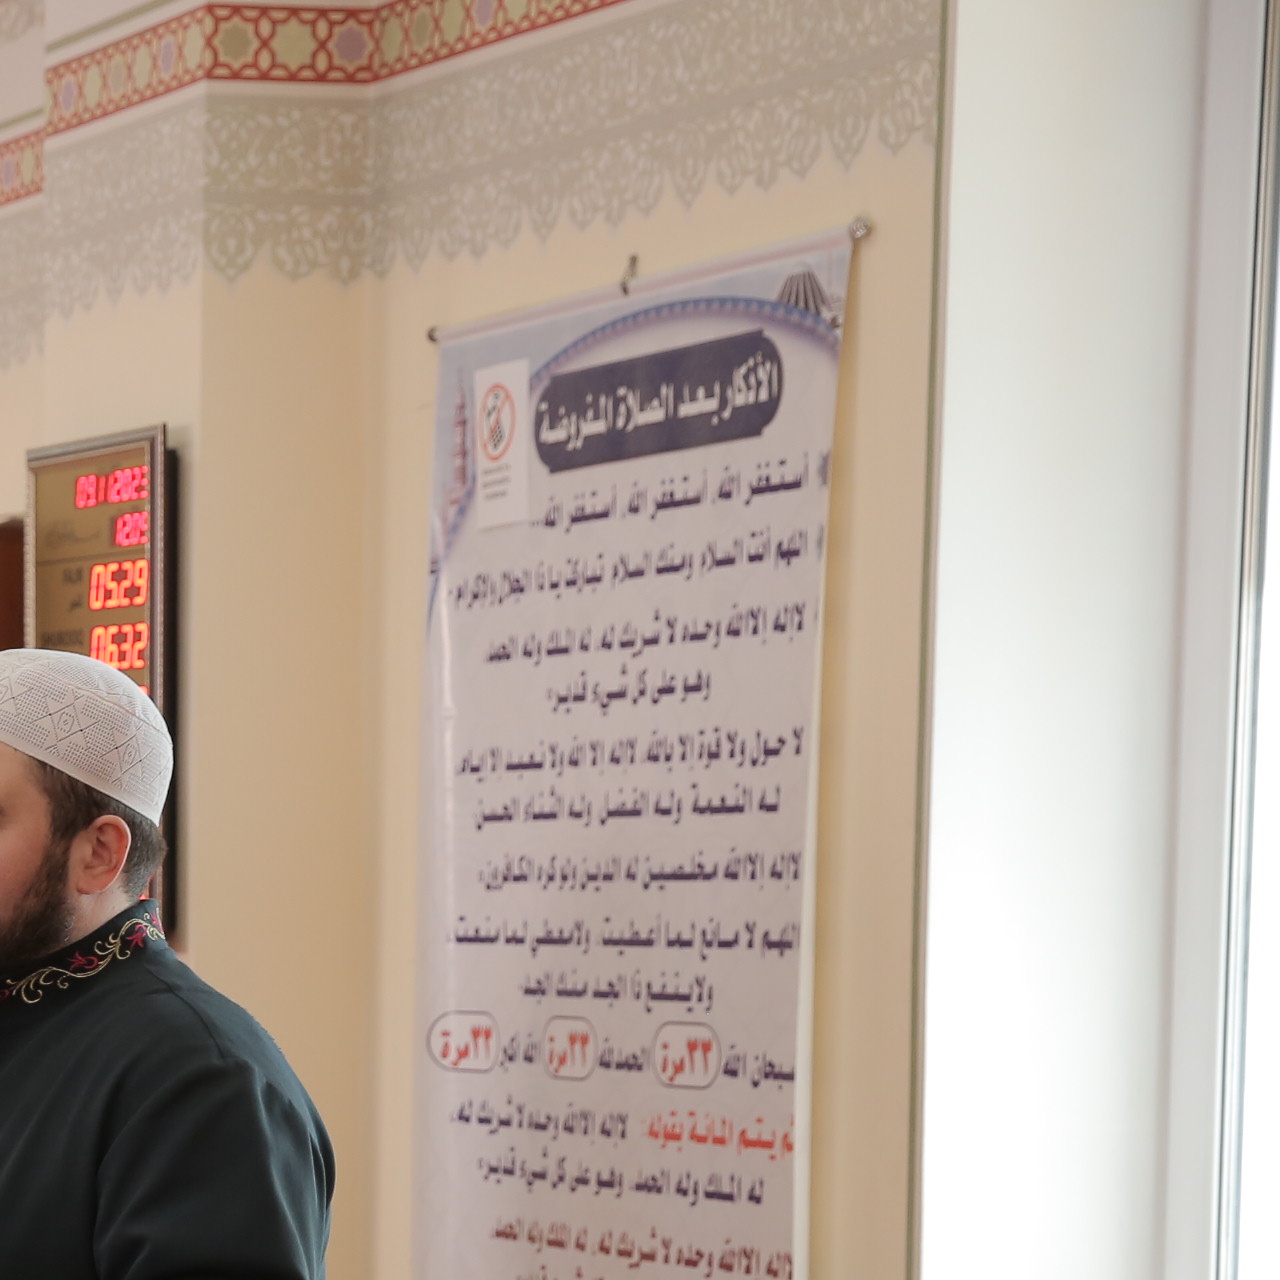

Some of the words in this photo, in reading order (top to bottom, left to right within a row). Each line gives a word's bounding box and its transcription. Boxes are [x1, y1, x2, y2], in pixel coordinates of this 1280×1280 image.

[616, 380, 674, 432] الصلاة
[677, 380, 721, 427] بعد
[720, 350, 779, 421] الأذكار
[538, 392, 614, 451] المفروضة
[655, 543, 693, 580] ومنك
[700, 538, 743, 577] السلام
[772, 529, 807, 570] اللهم
[90, 558, 148, 610] 0529
[611, 551, 651, 591] السلام
[91, 621, 148, 671] 0632
[619, 607, 660, 659] شريك
[751, 729, 787, 767] حول
[600, 787, 649, 827] الفضل
[654, 787, 681, 825] وله
[692, 782, 753, 814] النعمة
[759, 784, 780, 812] له
[642, 849, 718, 891] مخلصين
